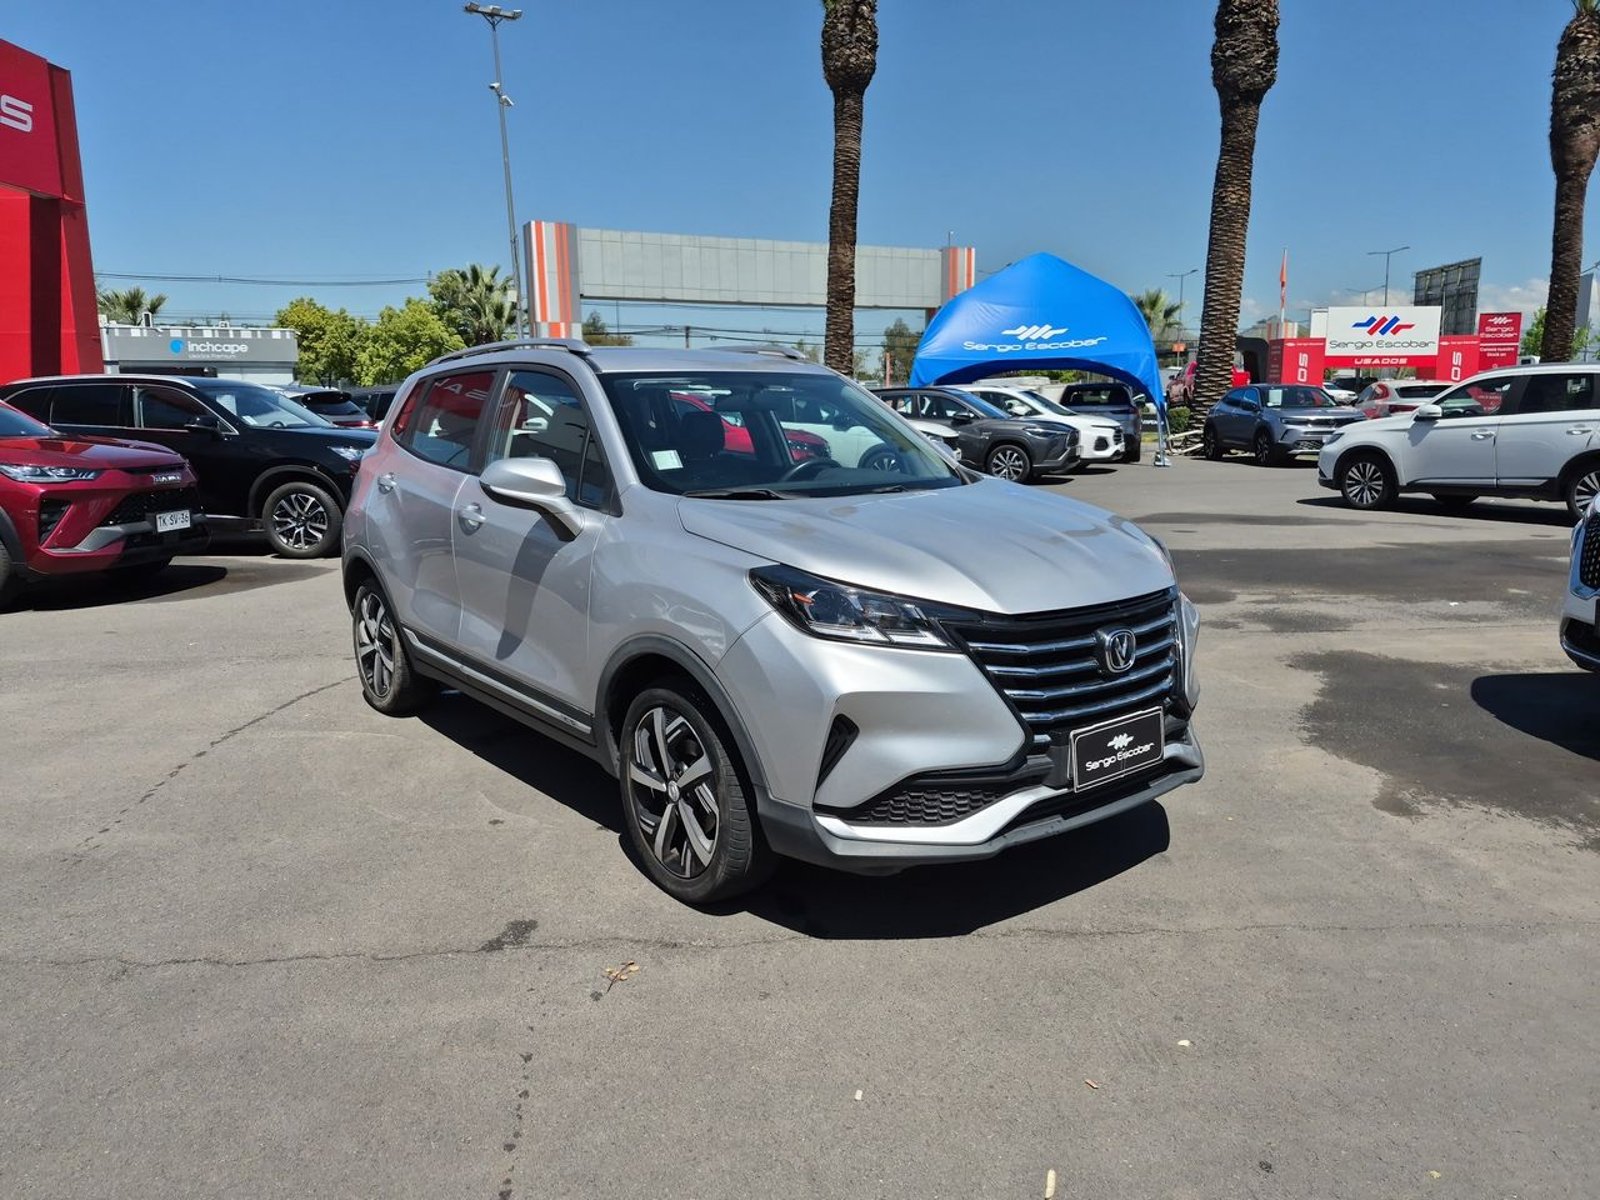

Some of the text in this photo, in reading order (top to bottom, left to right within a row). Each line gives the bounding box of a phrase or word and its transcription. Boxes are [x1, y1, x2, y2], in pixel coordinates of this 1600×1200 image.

[188, 341, 248, 354] inchcape
[1025, 336, 1108, 350] Escobar
[1376, 339, 1436, 348] Escobar
[1116, 742, 1155, 761] Escobar
